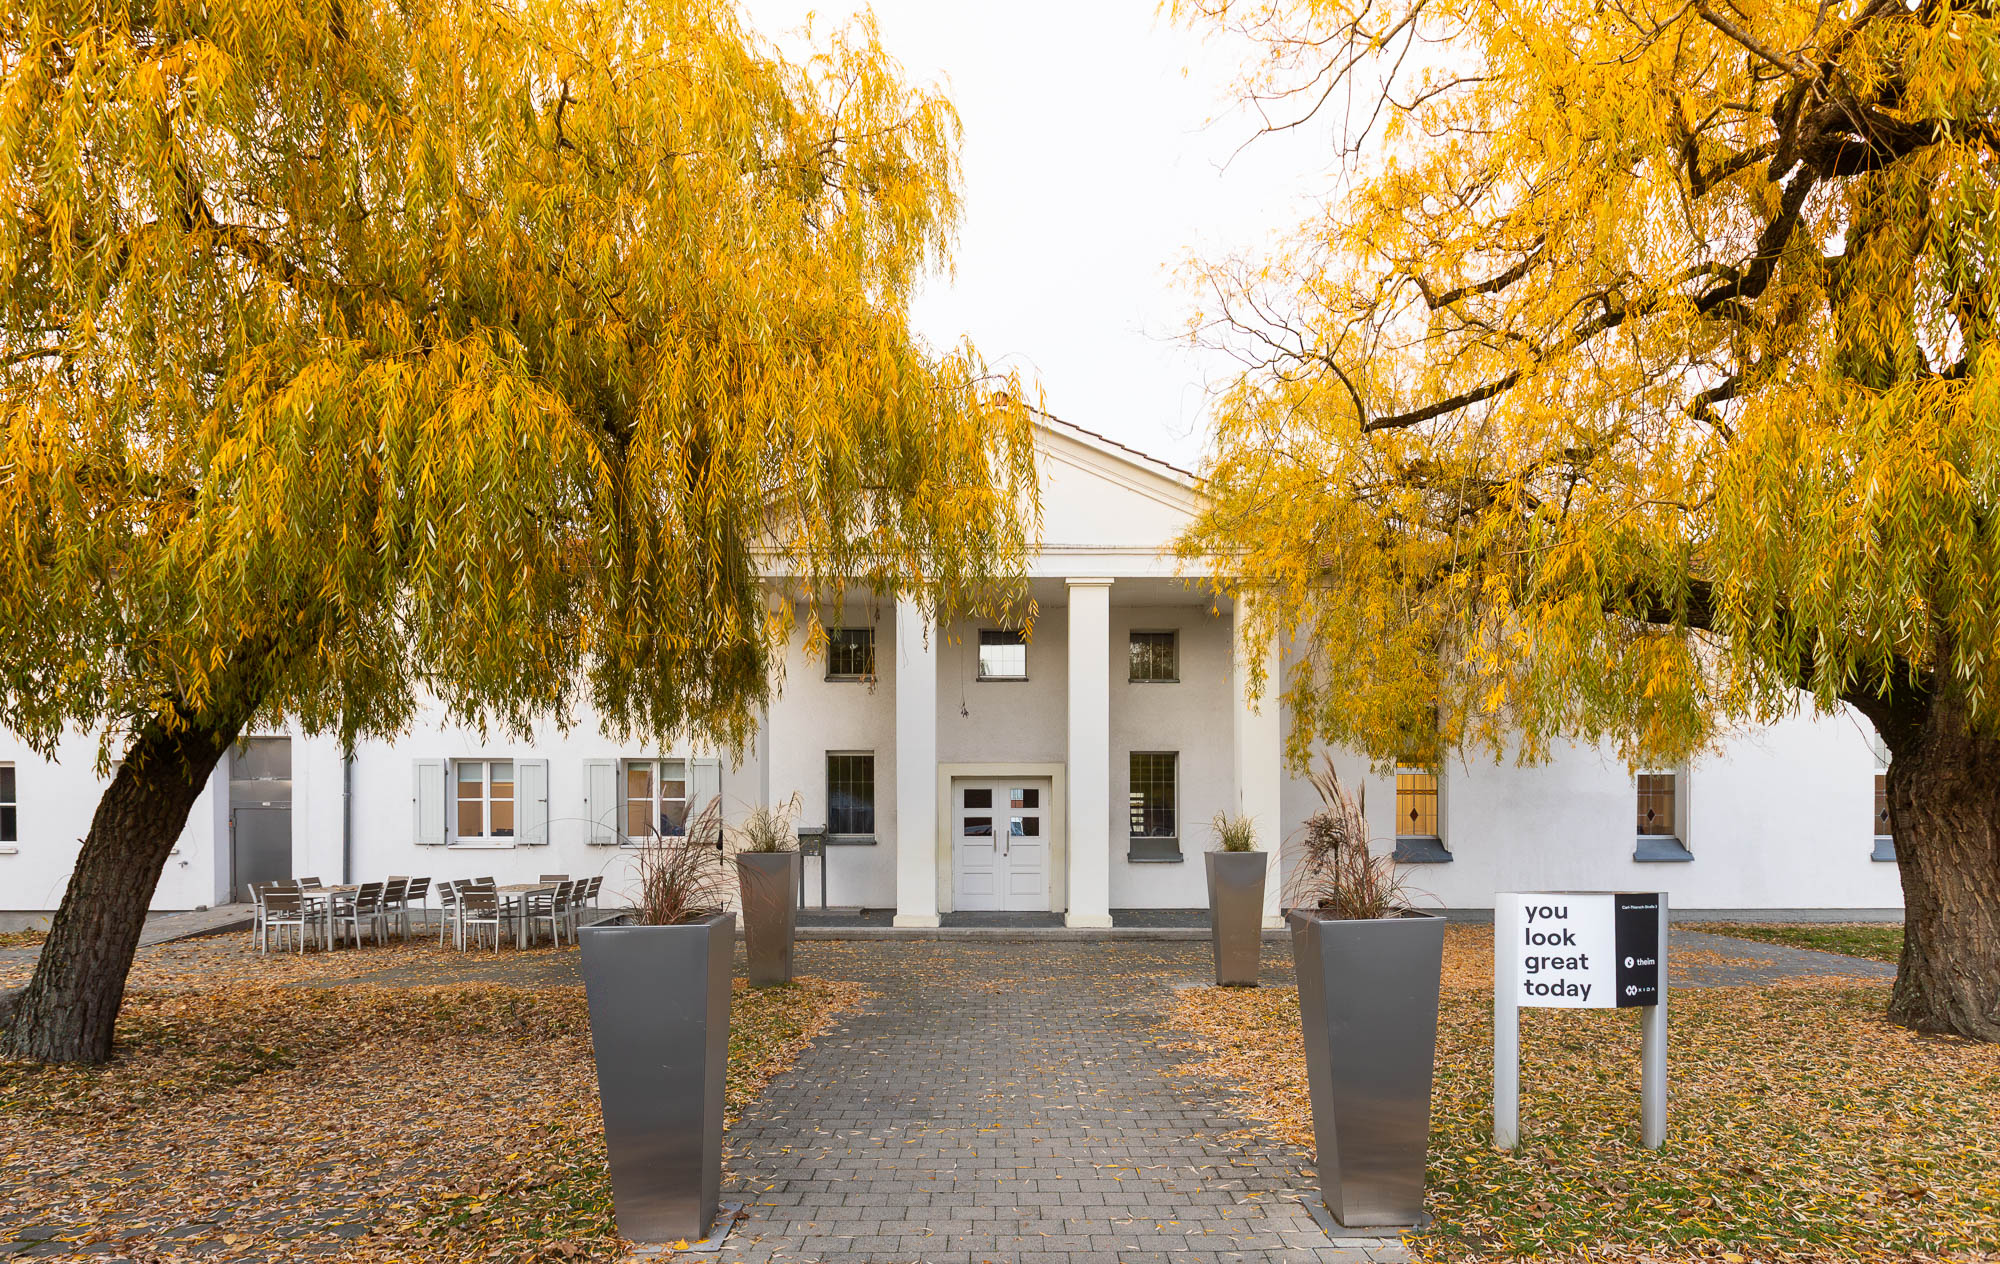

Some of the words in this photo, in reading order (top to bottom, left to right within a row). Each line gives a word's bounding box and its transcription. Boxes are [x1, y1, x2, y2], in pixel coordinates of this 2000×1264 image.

[1525, 906, 1568, 924] you
[1525, 928, 1577, 946] look
[1525, 954, 1589, 974] great
[1524, 979, 1592, 1002] today
